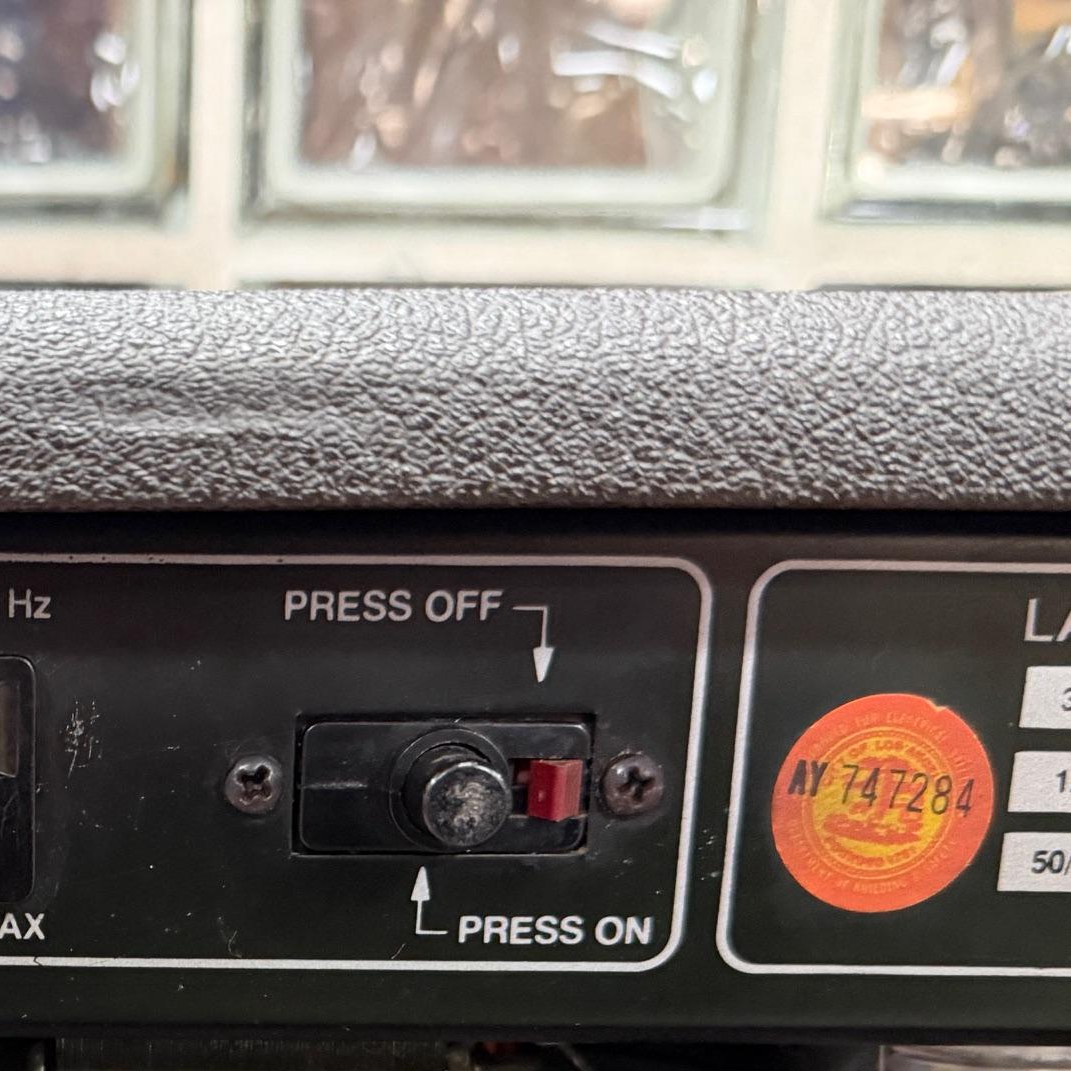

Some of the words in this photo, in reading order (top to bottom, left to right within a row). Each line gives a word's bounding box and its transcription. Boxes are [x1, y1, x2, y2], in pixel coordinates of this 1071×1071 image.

[7, 588, 52, 619] Hz
[284, 590, 413, 622] PRESS
[424, 590, 504, 622] OFF
[788, 759, 828, 797] AY
[840, 764, 975, 818] 747284
[458, 915, 585, 945] PRESS
[595, 916, 653, 946] ON
